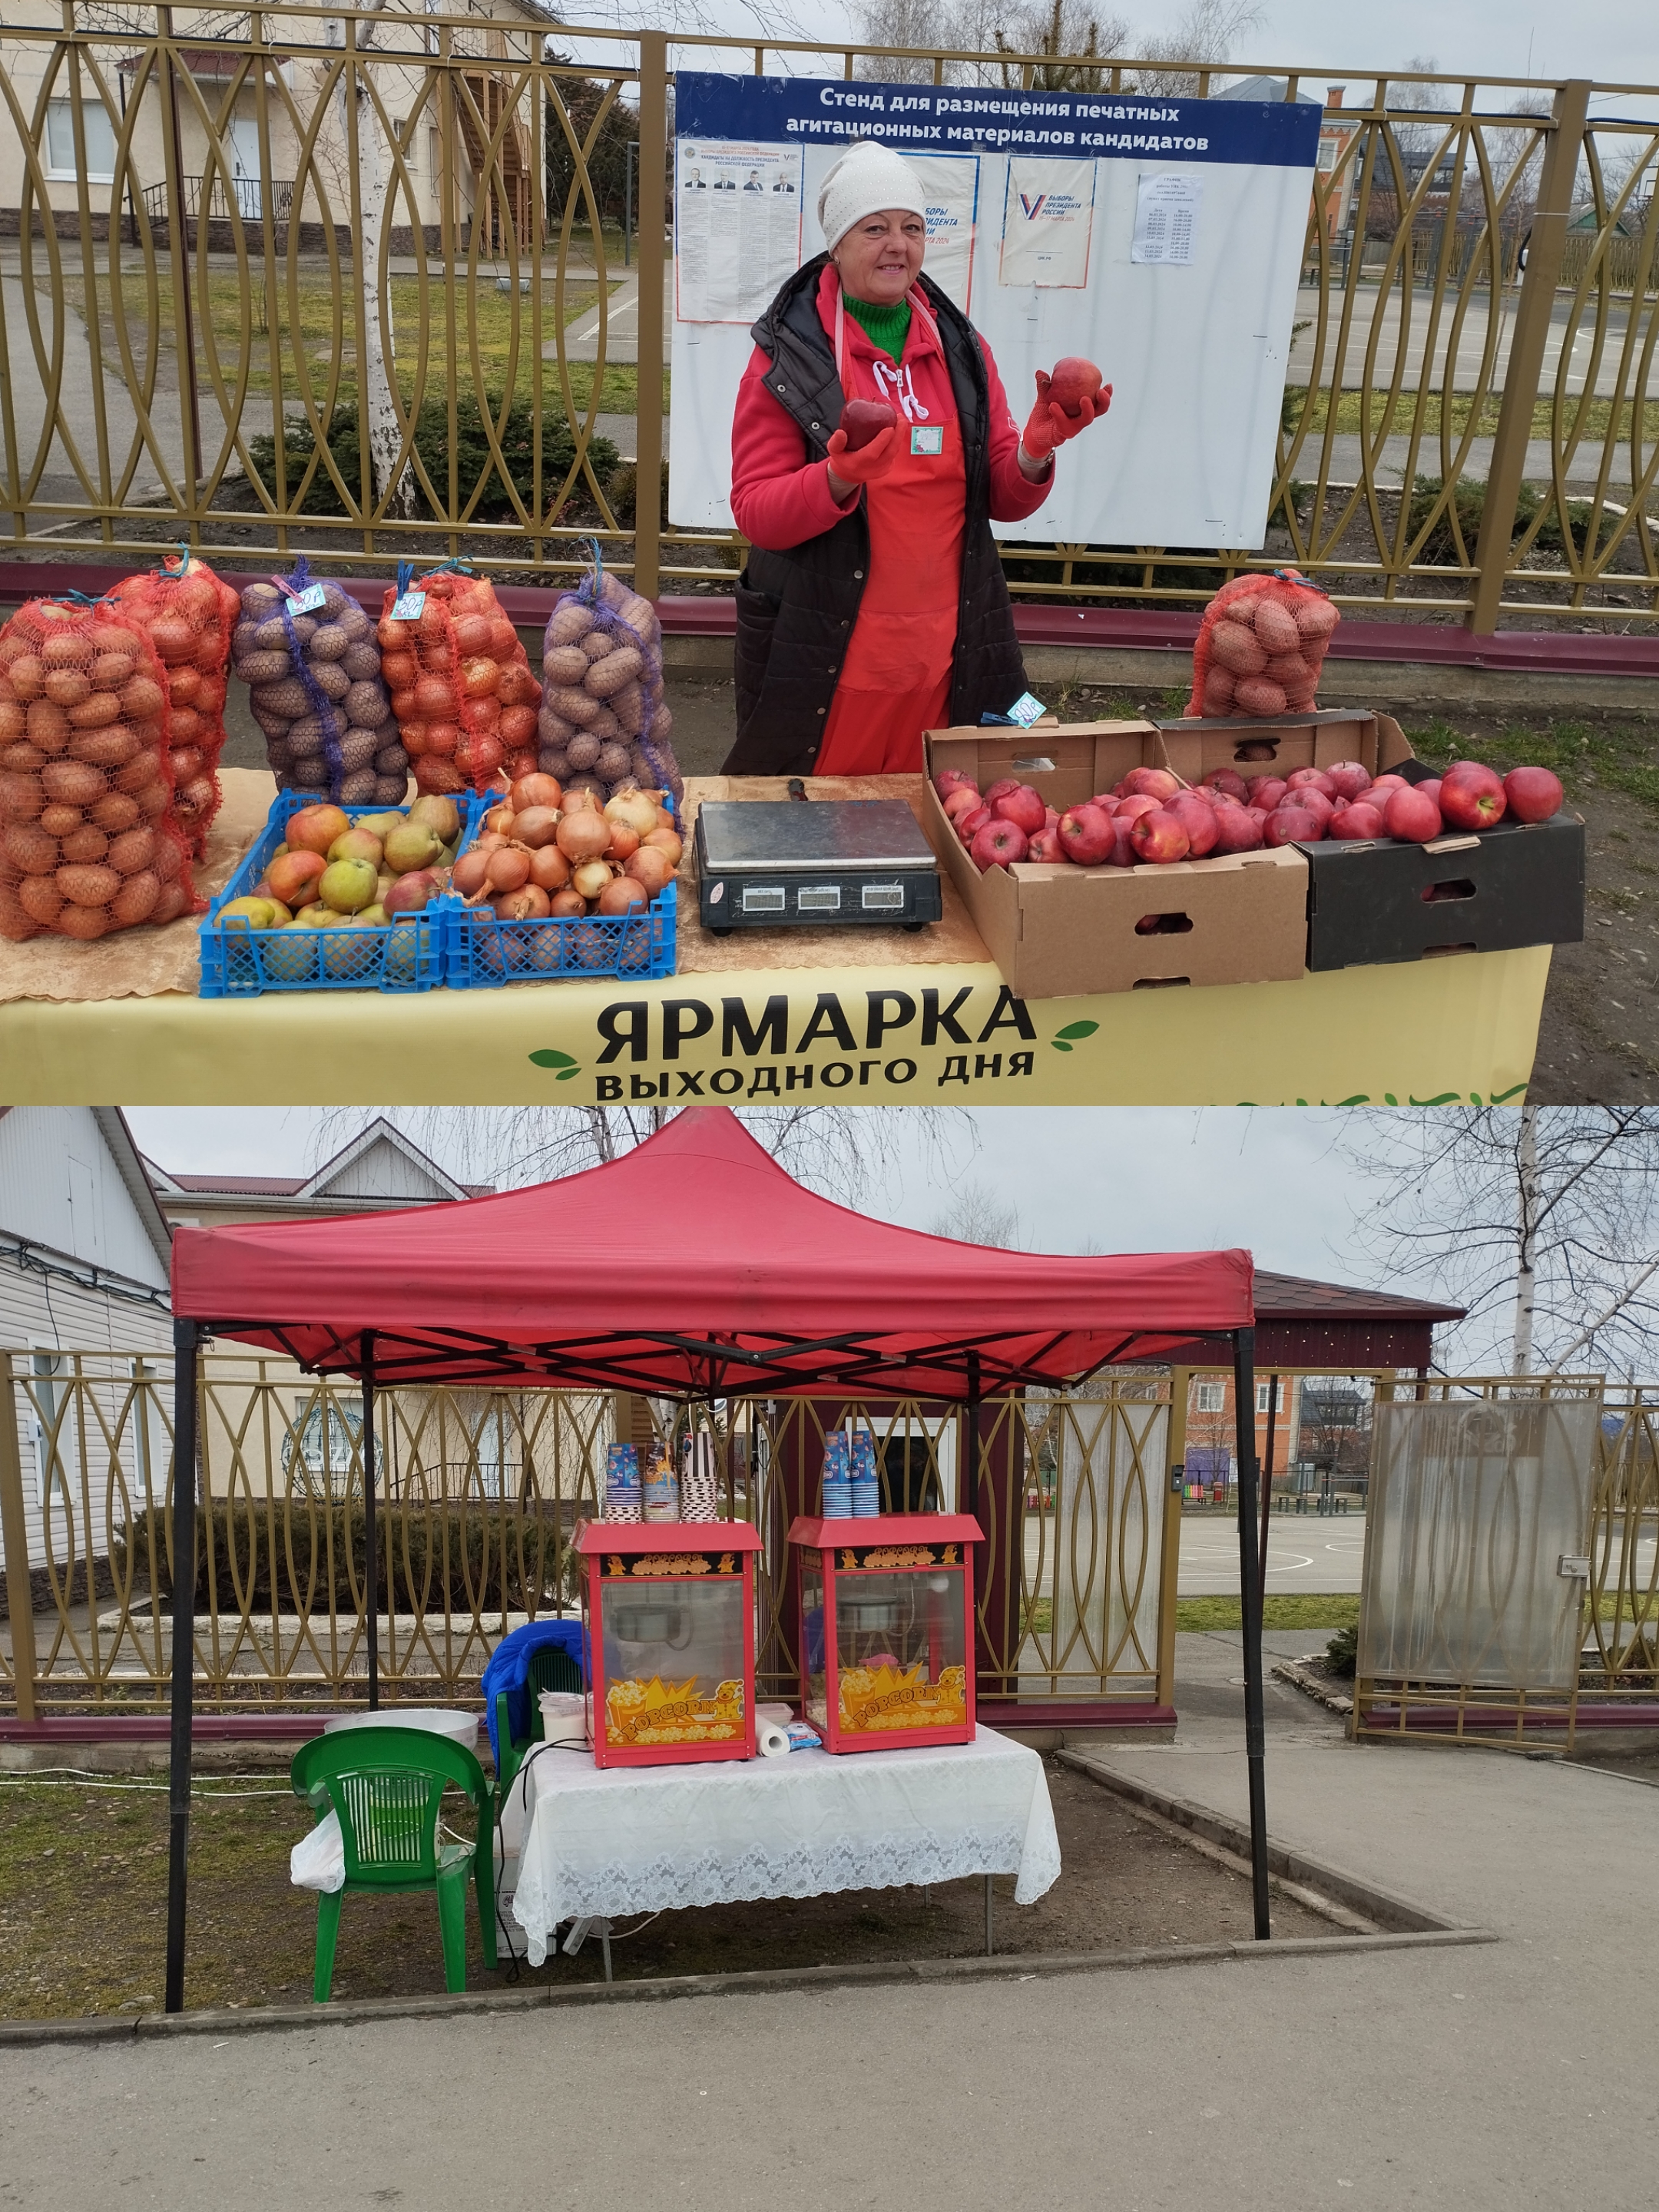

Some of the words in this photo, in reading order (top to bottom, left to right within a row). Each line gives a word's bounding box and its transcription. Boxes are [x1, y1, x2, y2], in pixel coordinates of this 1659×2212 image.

[820, 87, 885, 111] Стенд
[889, 96, 930, 112] для
[935, 98, 1070, 118] размещения
[1076, 104, 1180, 121] печатных
[786, 118, 942, 139] агитационных
[947, 127, 1075, 146] материалов
[1080, 132, 1209, 151] кандидатов
[926, 207, 949, 216] БОРЫ
[595, 984, 1038, 1065] ЯРМАРКА
[594, 1058, 918, 1101] ВЫХОДНОГО
[938, 1051, 1035, 1087] ДНЯ
[621, 1700, 717, 1741] POPCORN
[853, 1686, 940, 1727] POPCORN
